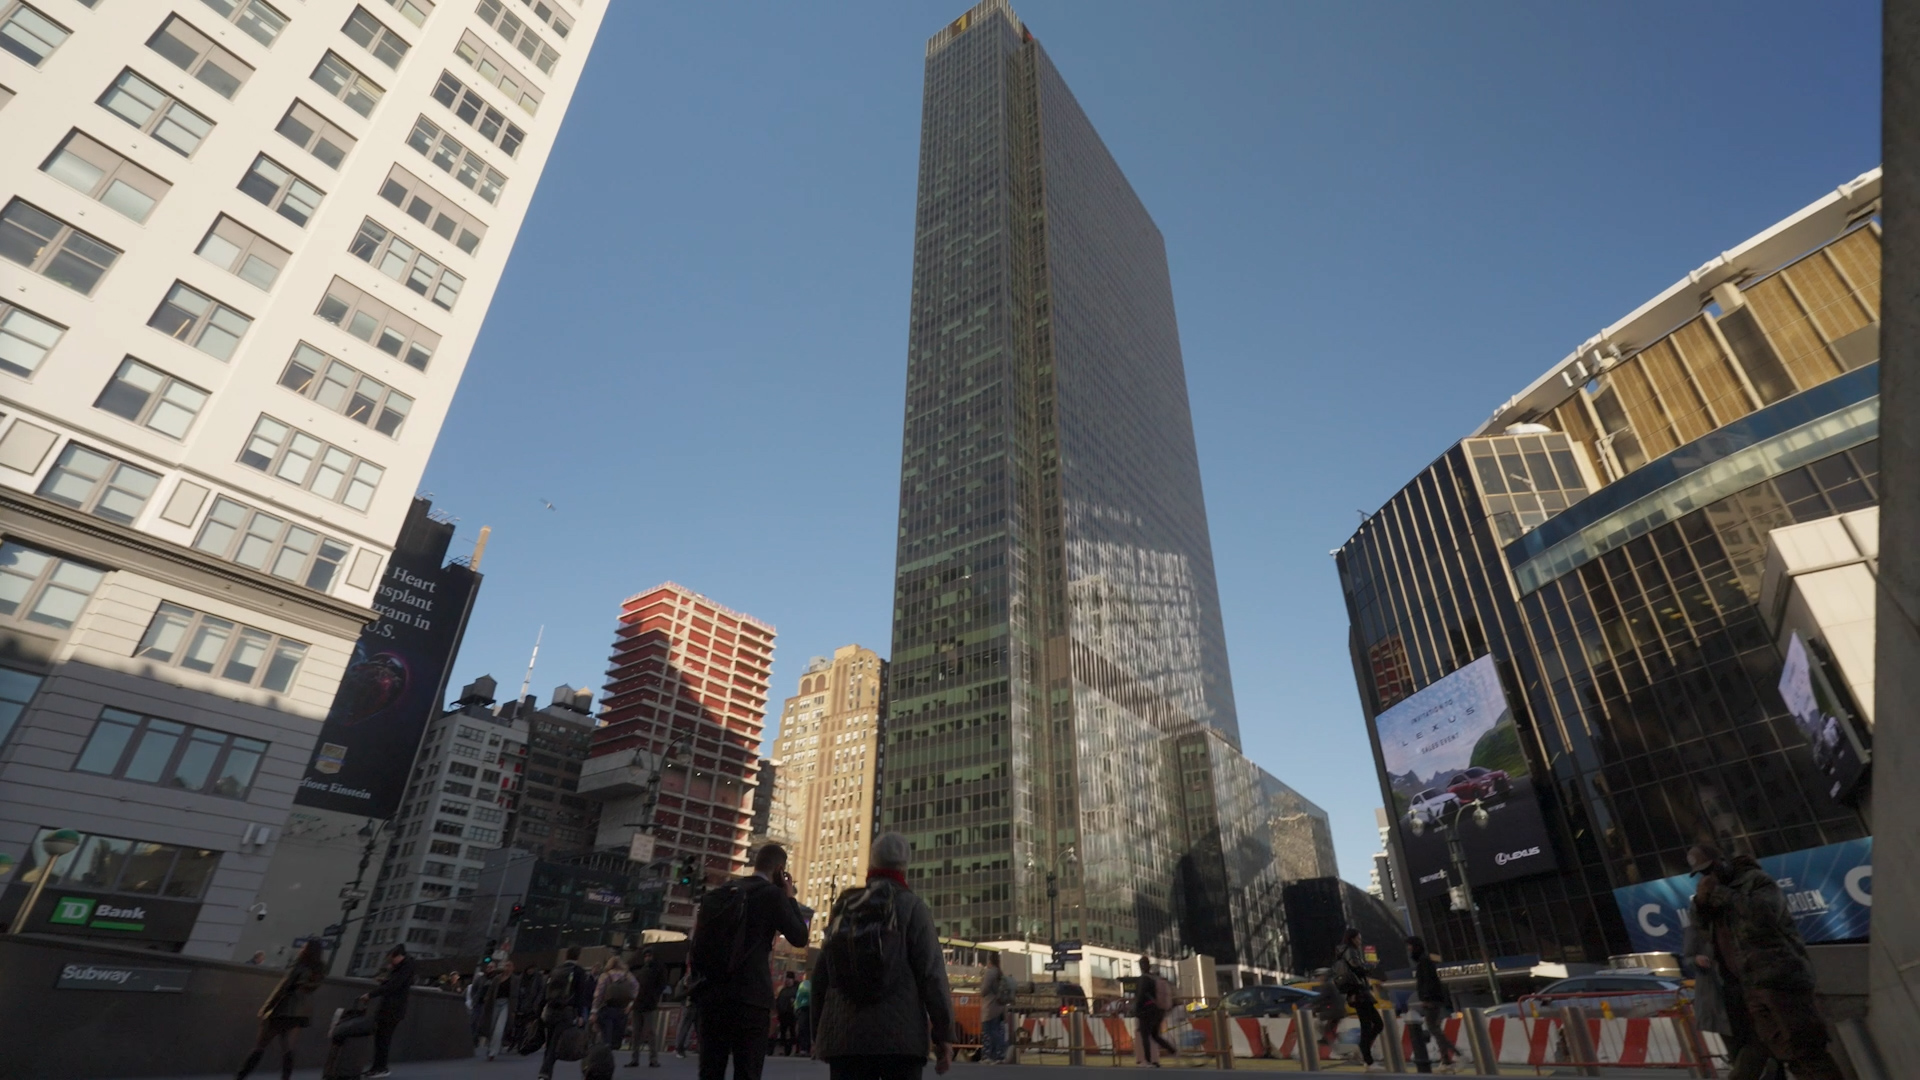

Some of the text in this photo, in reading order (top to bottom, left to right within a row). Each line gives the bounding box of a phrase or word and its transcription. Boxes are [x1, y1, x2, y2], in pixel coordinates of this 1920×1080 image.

[956, 14, 967, 32] 1
[392, 566, 437, 593] Heart
[413, 613, 432, 631] in
[1402, 706, 1475, 747] LEXUS
[1421, 732, 1460, 755] SALES EVENT
[329, 782, 372, 800] Einstein
[1506, 846, 1541, 861] LEXUS
[61, 902, 147, 920] TD Bank
[61, 965, 133, 985] Subway
